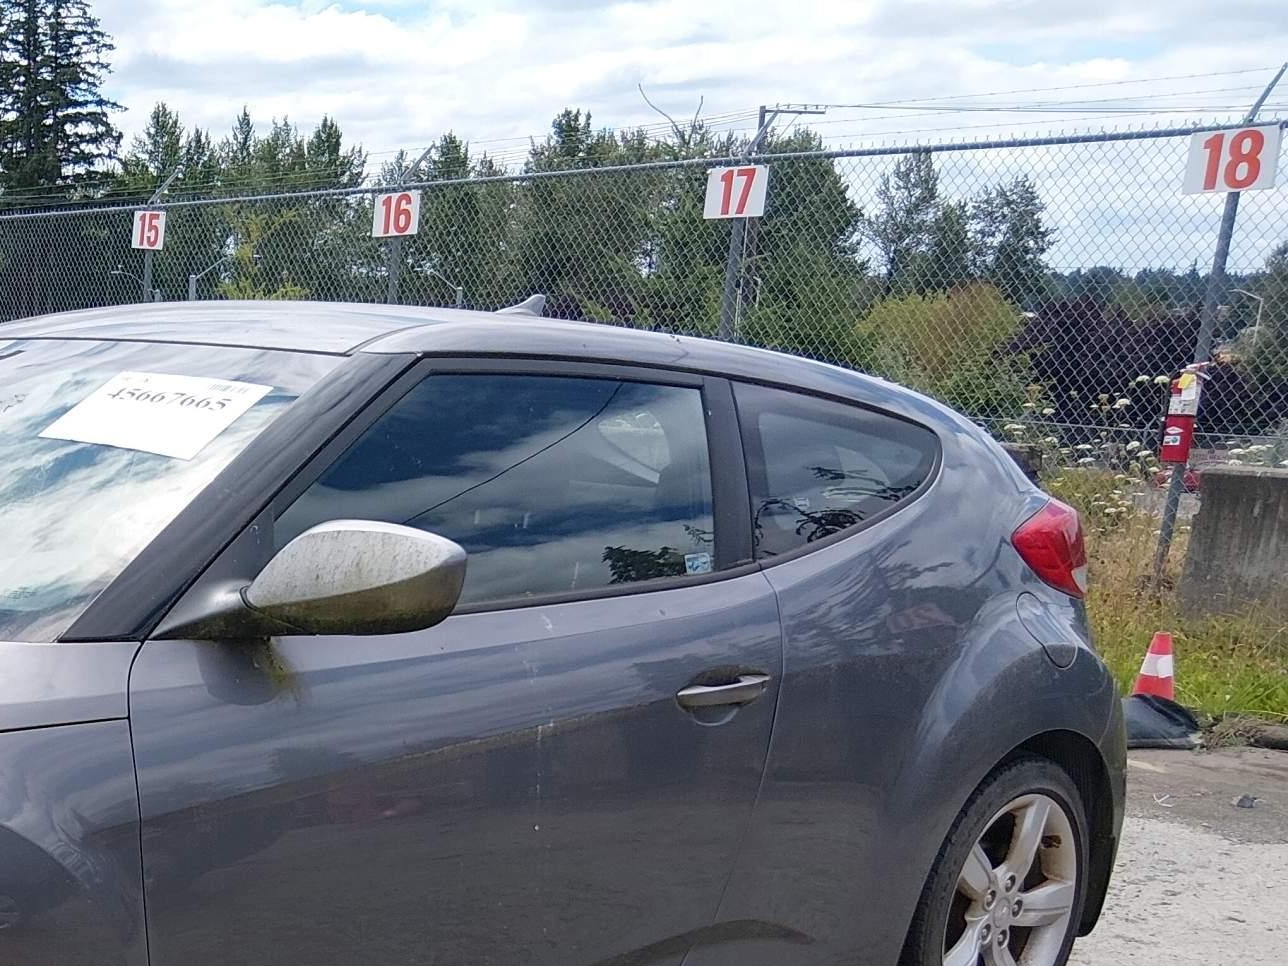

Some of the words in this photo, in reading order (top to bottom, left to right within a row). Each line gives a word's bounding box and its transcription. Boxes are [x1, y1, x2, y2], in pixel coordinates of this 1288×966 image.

[1203, 129, 1265, 190] 18
[720, 167, 757, 215] 17
[138, 212, 160, 248] 15
[382, 193, 412, 234] 16
[107, 386, 232, 411] 45667665
